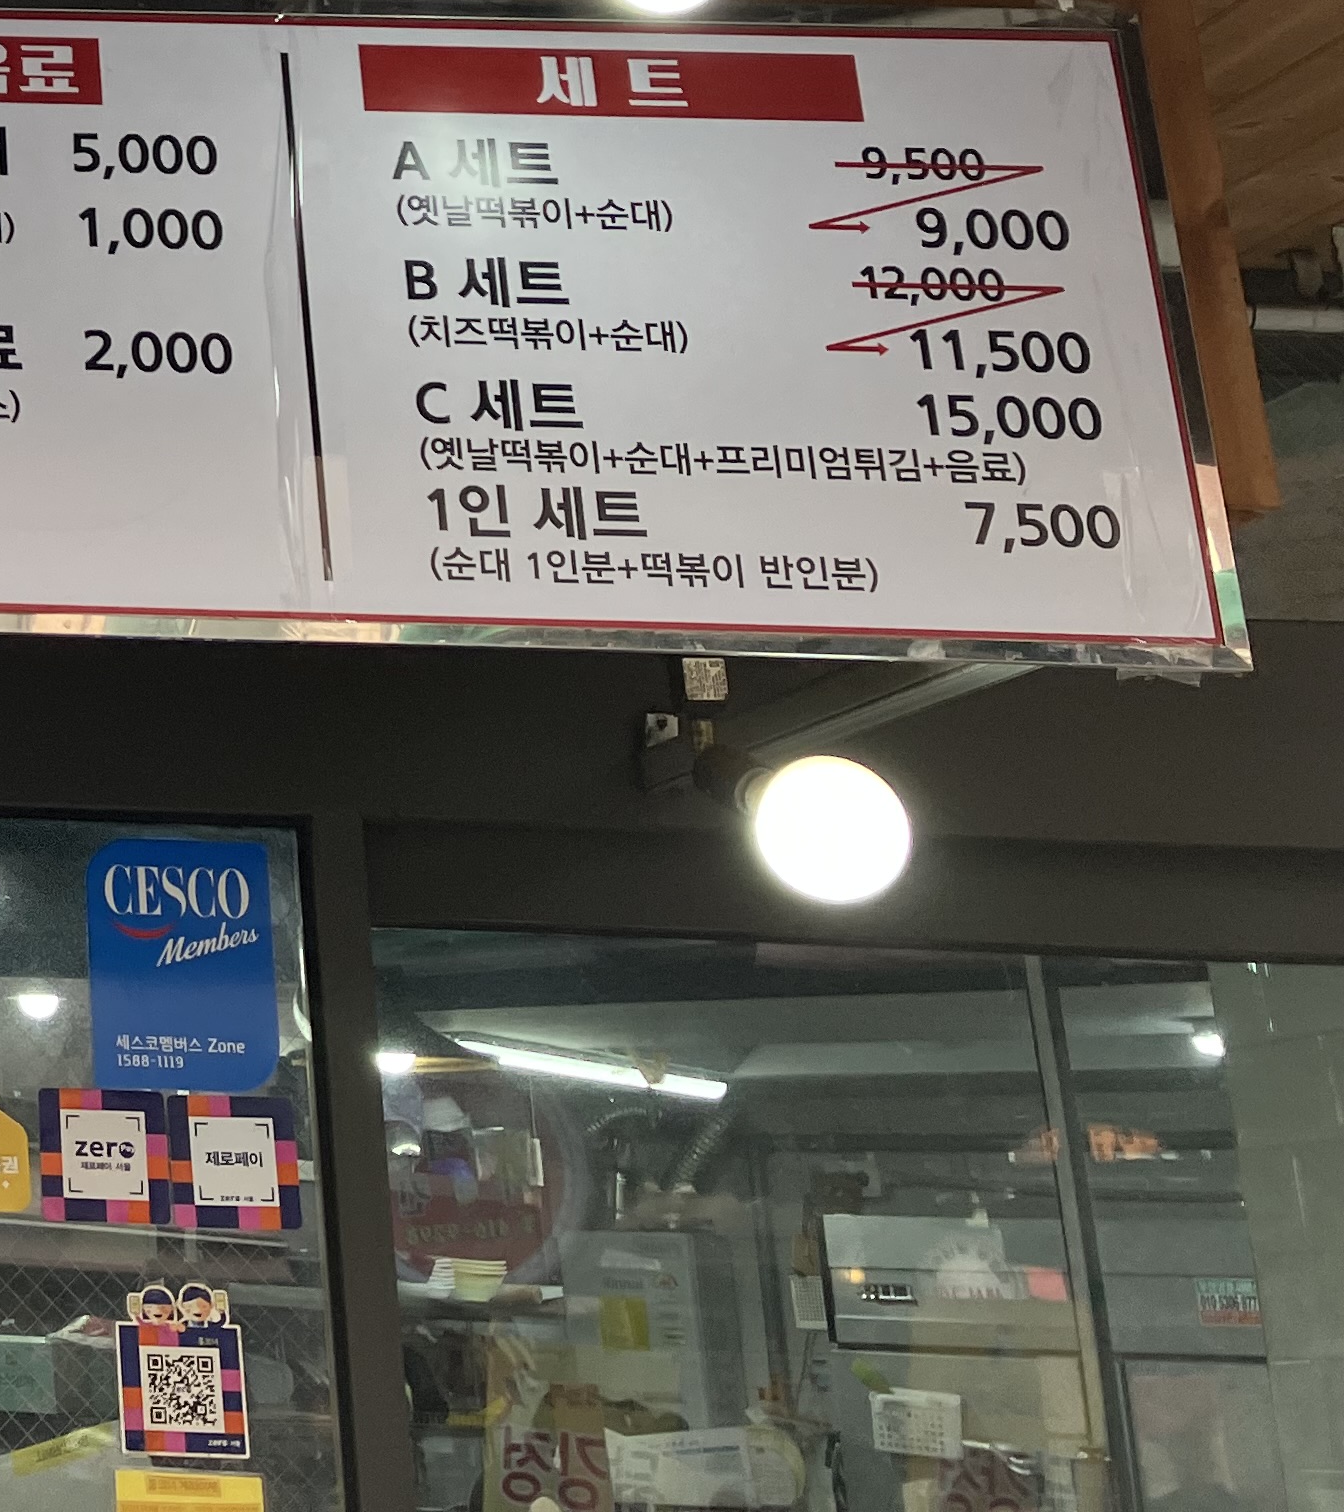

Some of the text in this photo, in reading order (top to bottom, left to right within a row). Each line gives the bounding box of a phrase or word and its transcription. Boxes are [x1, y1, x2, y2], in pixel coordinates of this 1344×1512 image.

[537, 57, 688, 106] 세트
[73, 133, 217, 180] 5,000
[393, 139, 986, 188] A 세트 9,500
[79, 207, 223, 255] 1,000
[396, 194, 1069, 256] (옛날떡볶이+순대) 9,000
[404, 256, 1007, 308] B 세트 12,000
[84, 329, 233, 379] 2,000
[408, 315, 1092, 377] (치즈떡볶이+순대) 11,500
[416, 379, 1102, 445] C 세트 15,000
[427, 484, 1120, 553] 1인 세트 7,500
[431, 547, 878, 593] (순대 1인분+떡볶이 반인분)
[104, 864, 250, 919] CESCO
[156, 922, 259, 967] Members
[116, 1034, 245, 1053] 세스코멤버스 Zone
[118, 1054, 184, 1069] 1588-1119
[205, 1151, 263, 1167] 제로페이
